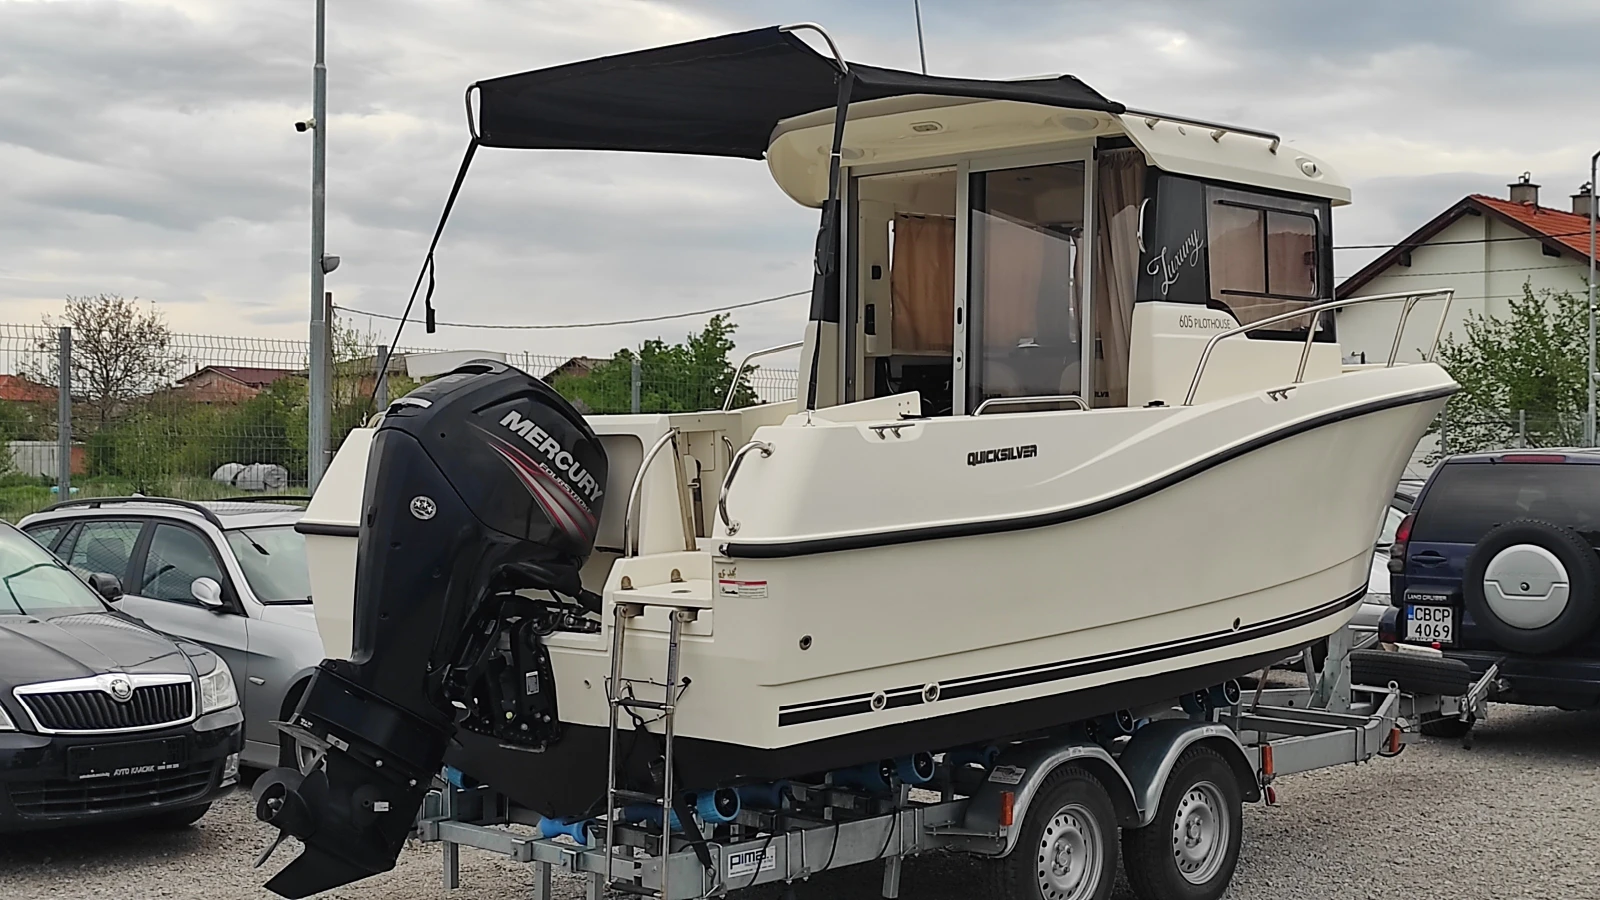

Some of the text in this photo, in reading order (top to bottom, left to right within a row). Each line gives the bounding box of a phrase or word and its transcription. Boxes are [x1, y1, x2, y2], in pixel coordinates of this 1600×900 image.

[1147, 229, 1203, 295] Luxury
[1179, 315, 1231, 329] 605 PILOTHOUSE
[500, 410, 603, 501] MERCURY
[967, 444, 1038, 466] QUICKSILVER
[540, 462, 592, 513] FOURSTROKE
[1414, 623, 1450, 639] 4069
